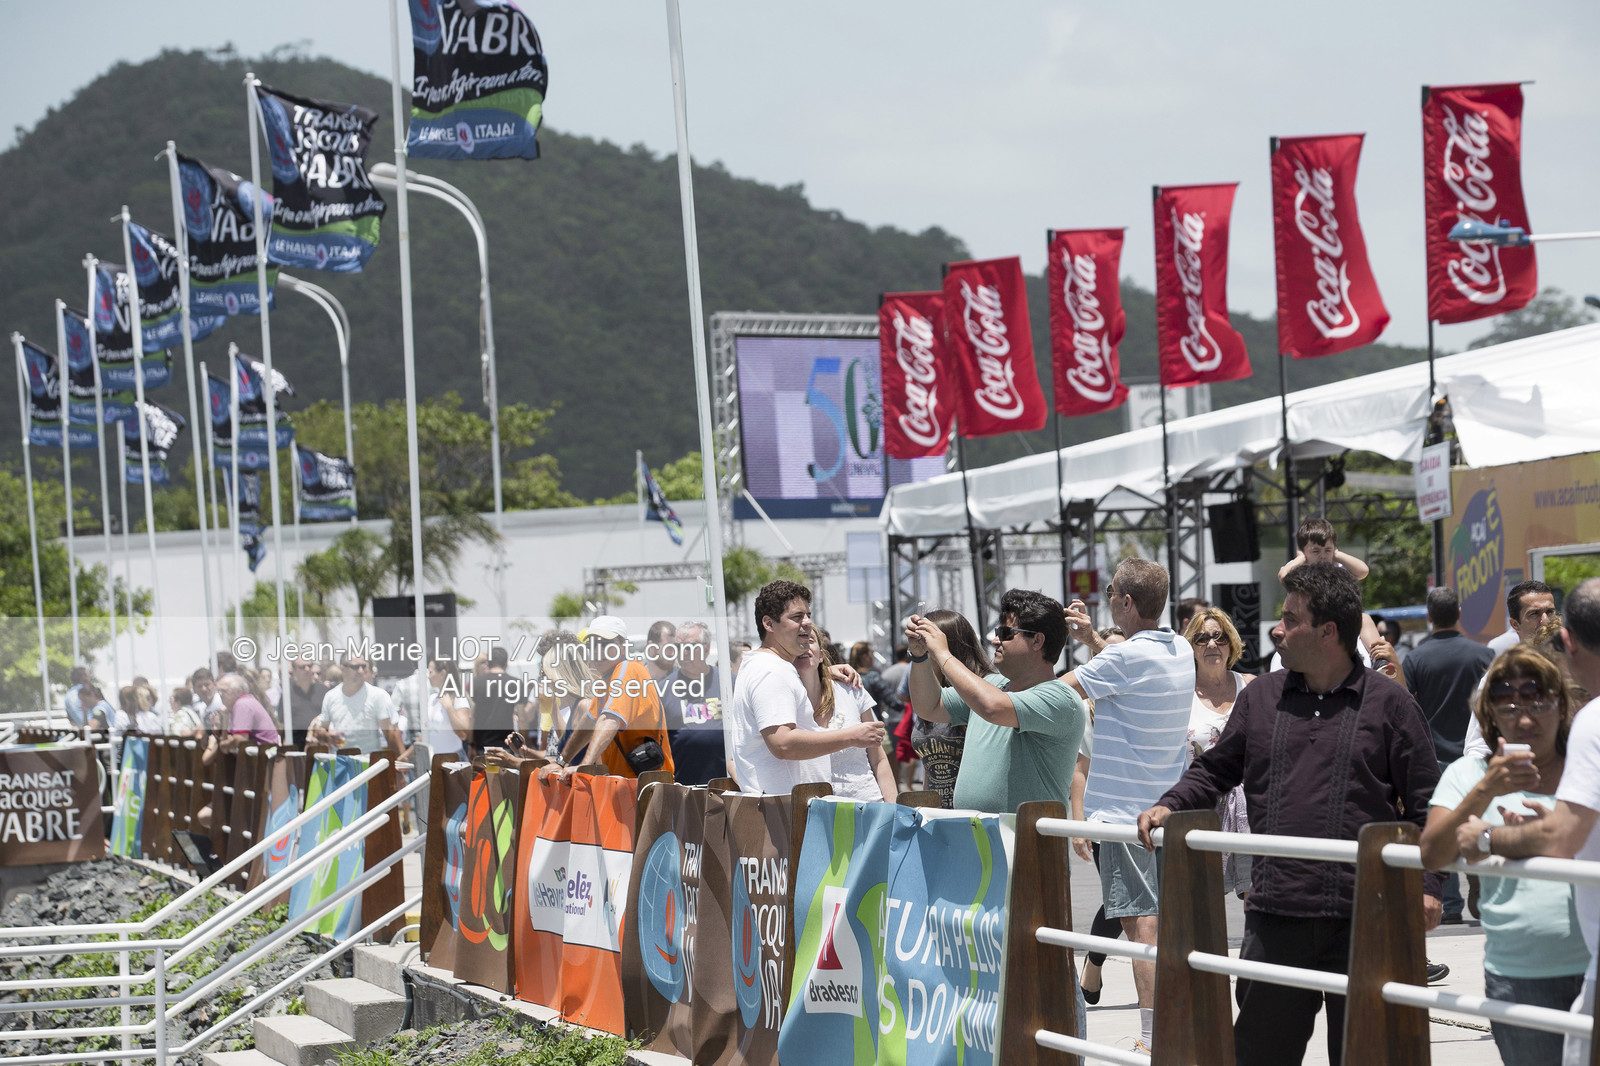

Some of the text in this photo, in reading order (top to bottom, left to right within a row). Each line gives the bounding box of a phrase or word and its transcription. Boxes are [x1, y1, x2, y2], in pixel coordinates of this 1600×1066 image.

[1457, 535, 1501, 604] FROOTY
[809, 979, 859, 1005] Bradesco
[905, 978, 947, 1044] DO
